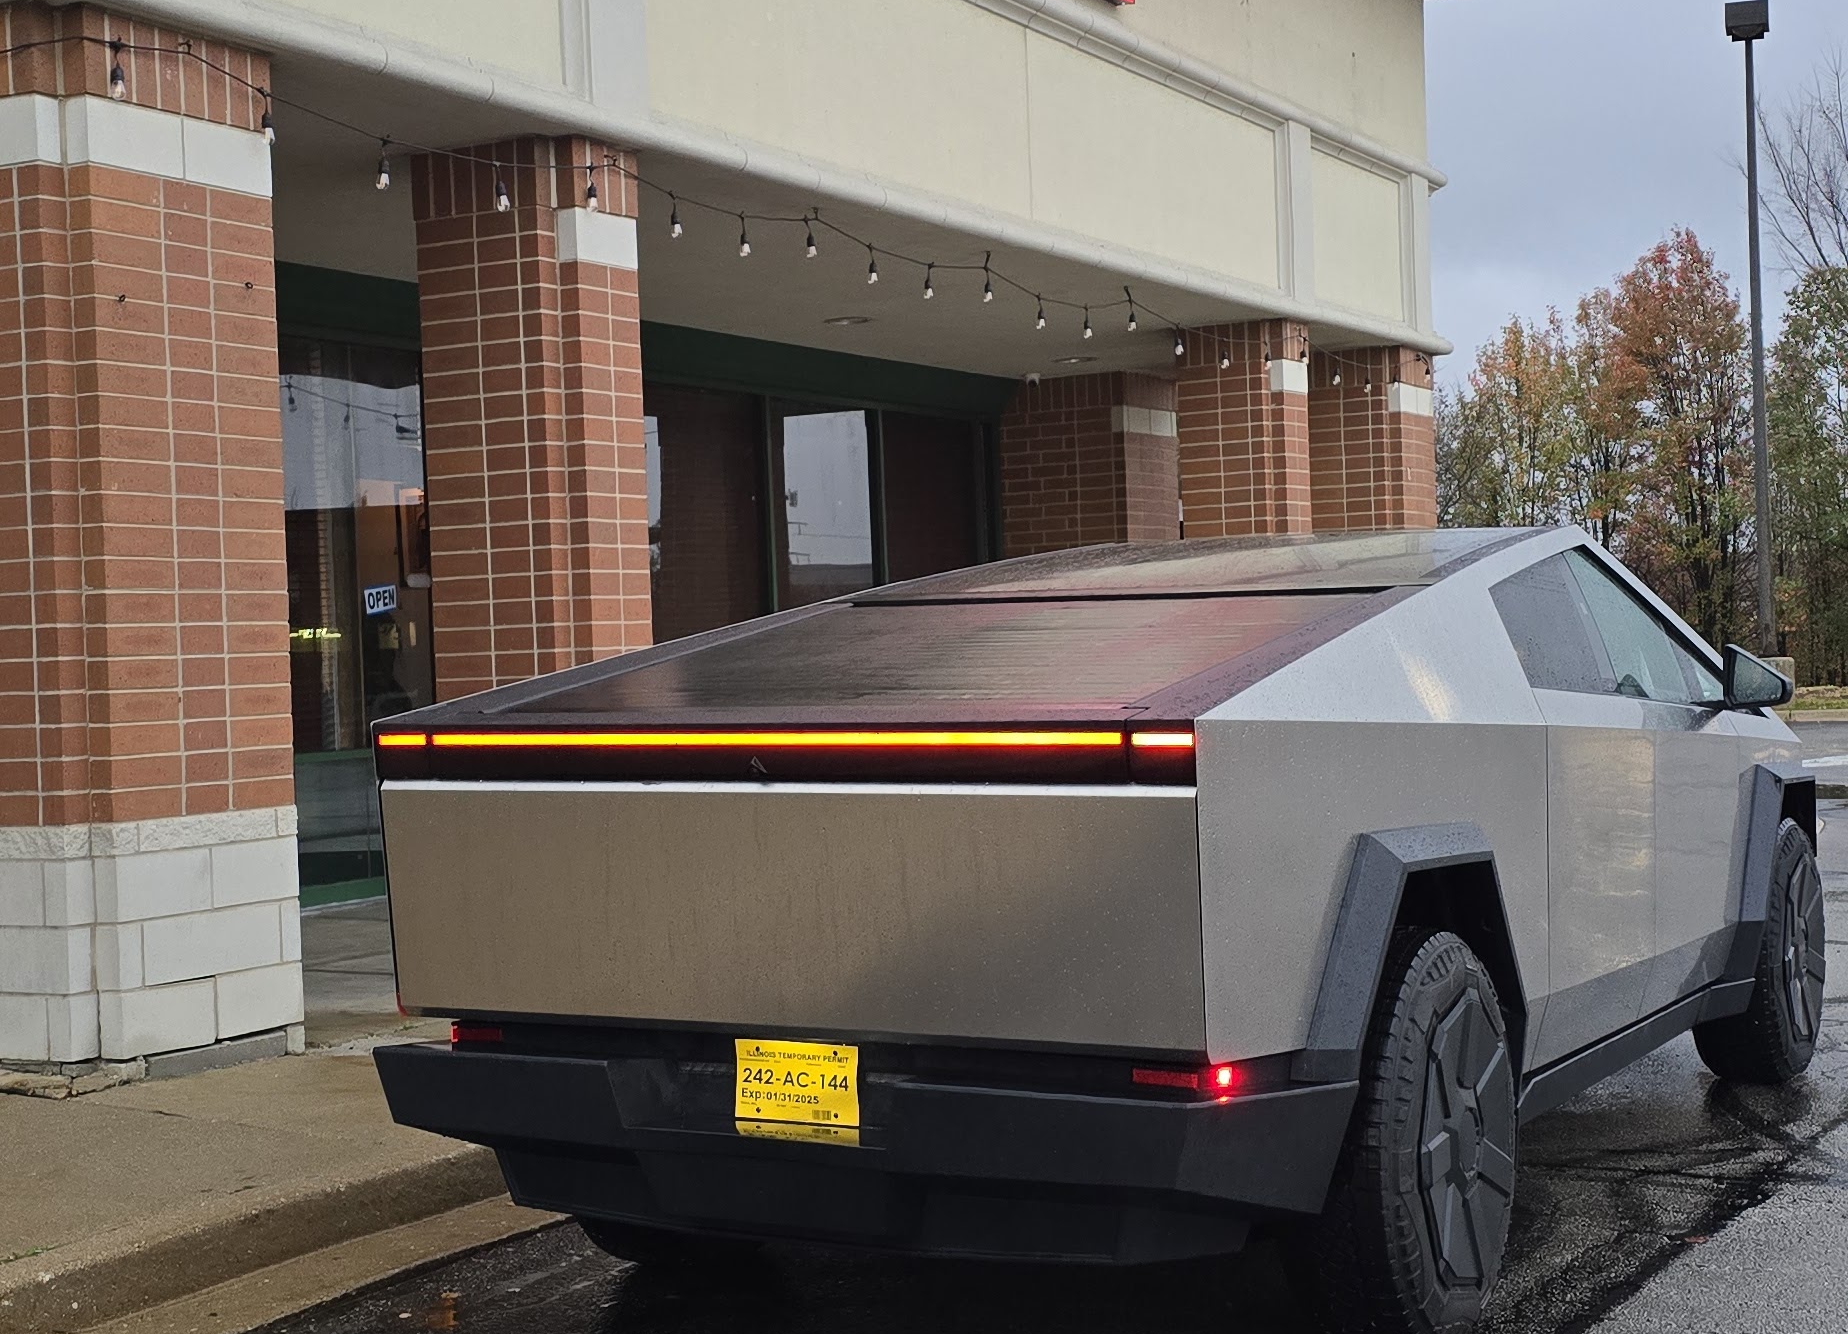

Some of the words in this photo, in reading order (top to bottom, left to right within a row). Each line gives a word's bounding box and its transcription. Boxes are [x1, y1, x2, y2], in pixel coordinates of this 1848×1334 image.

[368, 588, 394, 609] OPEN
[746, 1050, 776, 1059] ILLINOIS
[778, 1052, 821, 1062] TEMPORARY
[823, 1055, 849, 1064] PERMIT
[742, 1067, 849, 1091] 242-AC-144
